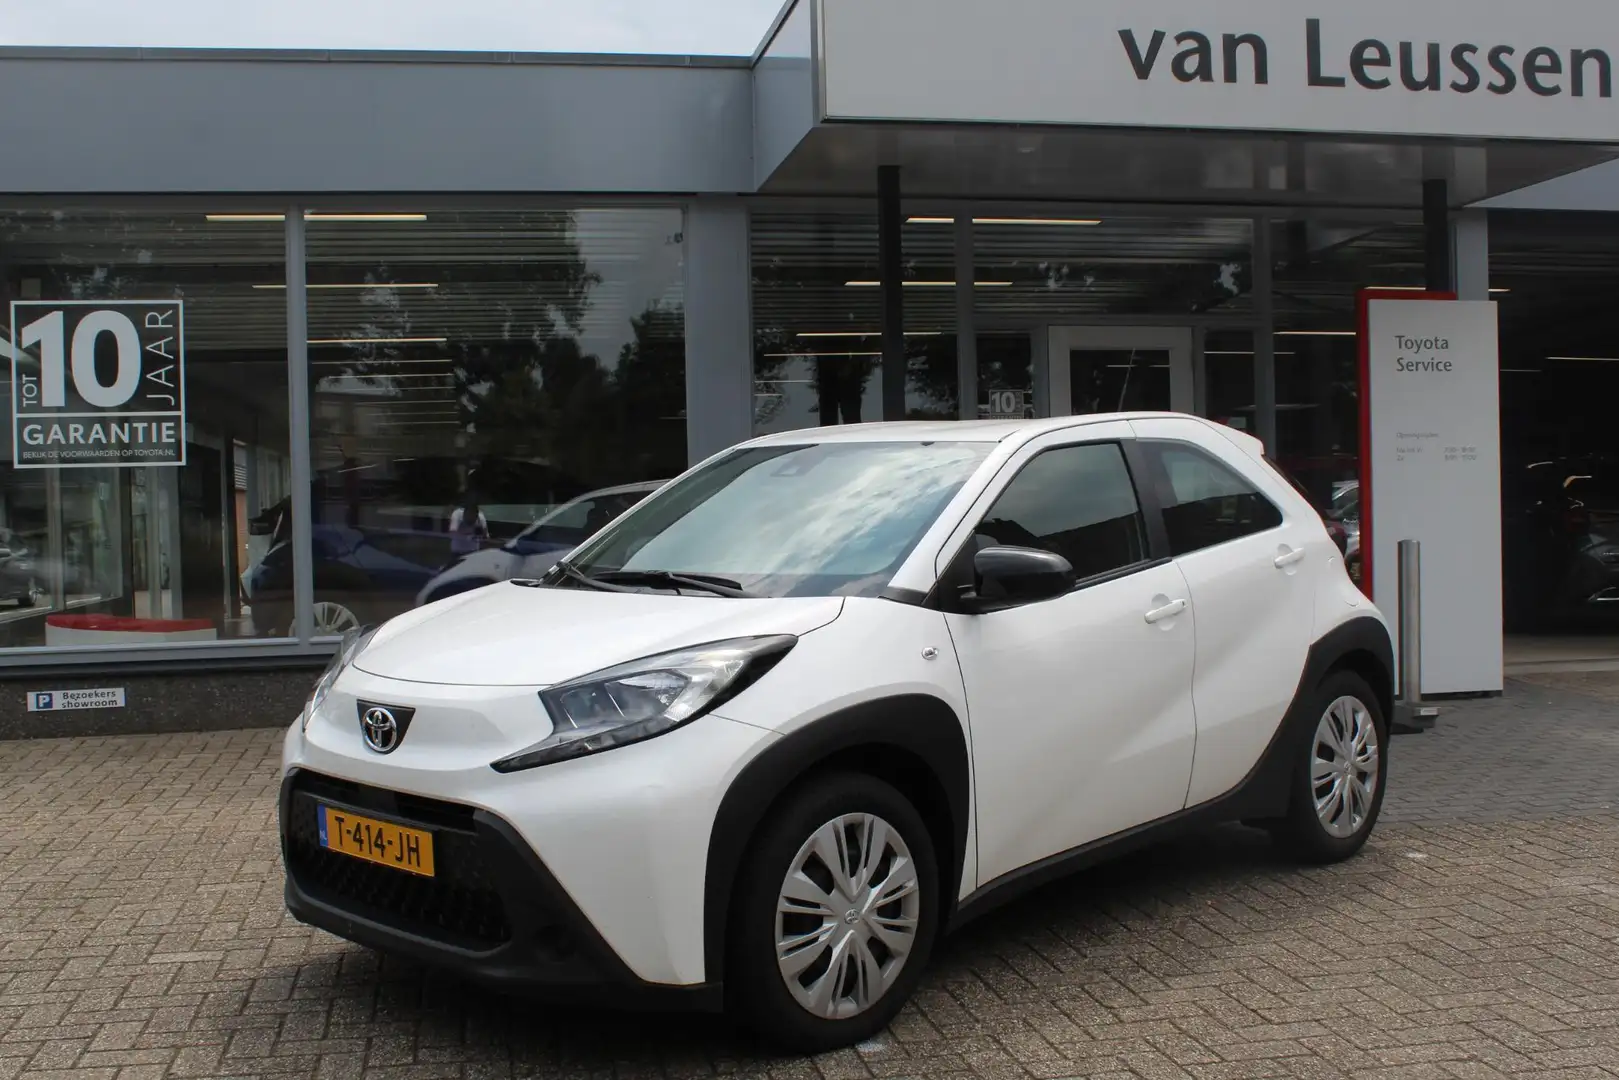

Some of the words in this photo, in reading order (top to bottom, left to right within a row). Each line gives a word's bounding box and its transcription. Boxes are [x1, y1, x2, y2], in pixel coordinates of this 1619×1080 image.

[1117, 28, 1268, 85] van
[1305, 18, 1612, 98] Leussen
[1394, 335, 1449, 354] Toyota
[21, 310, 141, 407] 10
[145, 310, 174, 406] JAAR
[1396, 357, 1452, 372] Service
[23, 374, 37, 407] TOT
[991, 391, 1015, 412] 10
[23, 422, 175, 445] GARANTIE
[60, 449, 120, 458] VOORWAARDEN
[61, 699, 118, 709] showroom
[62, 690, 116, 700] Bezoekers
[335, 815, 420, 867] T-414-JH
